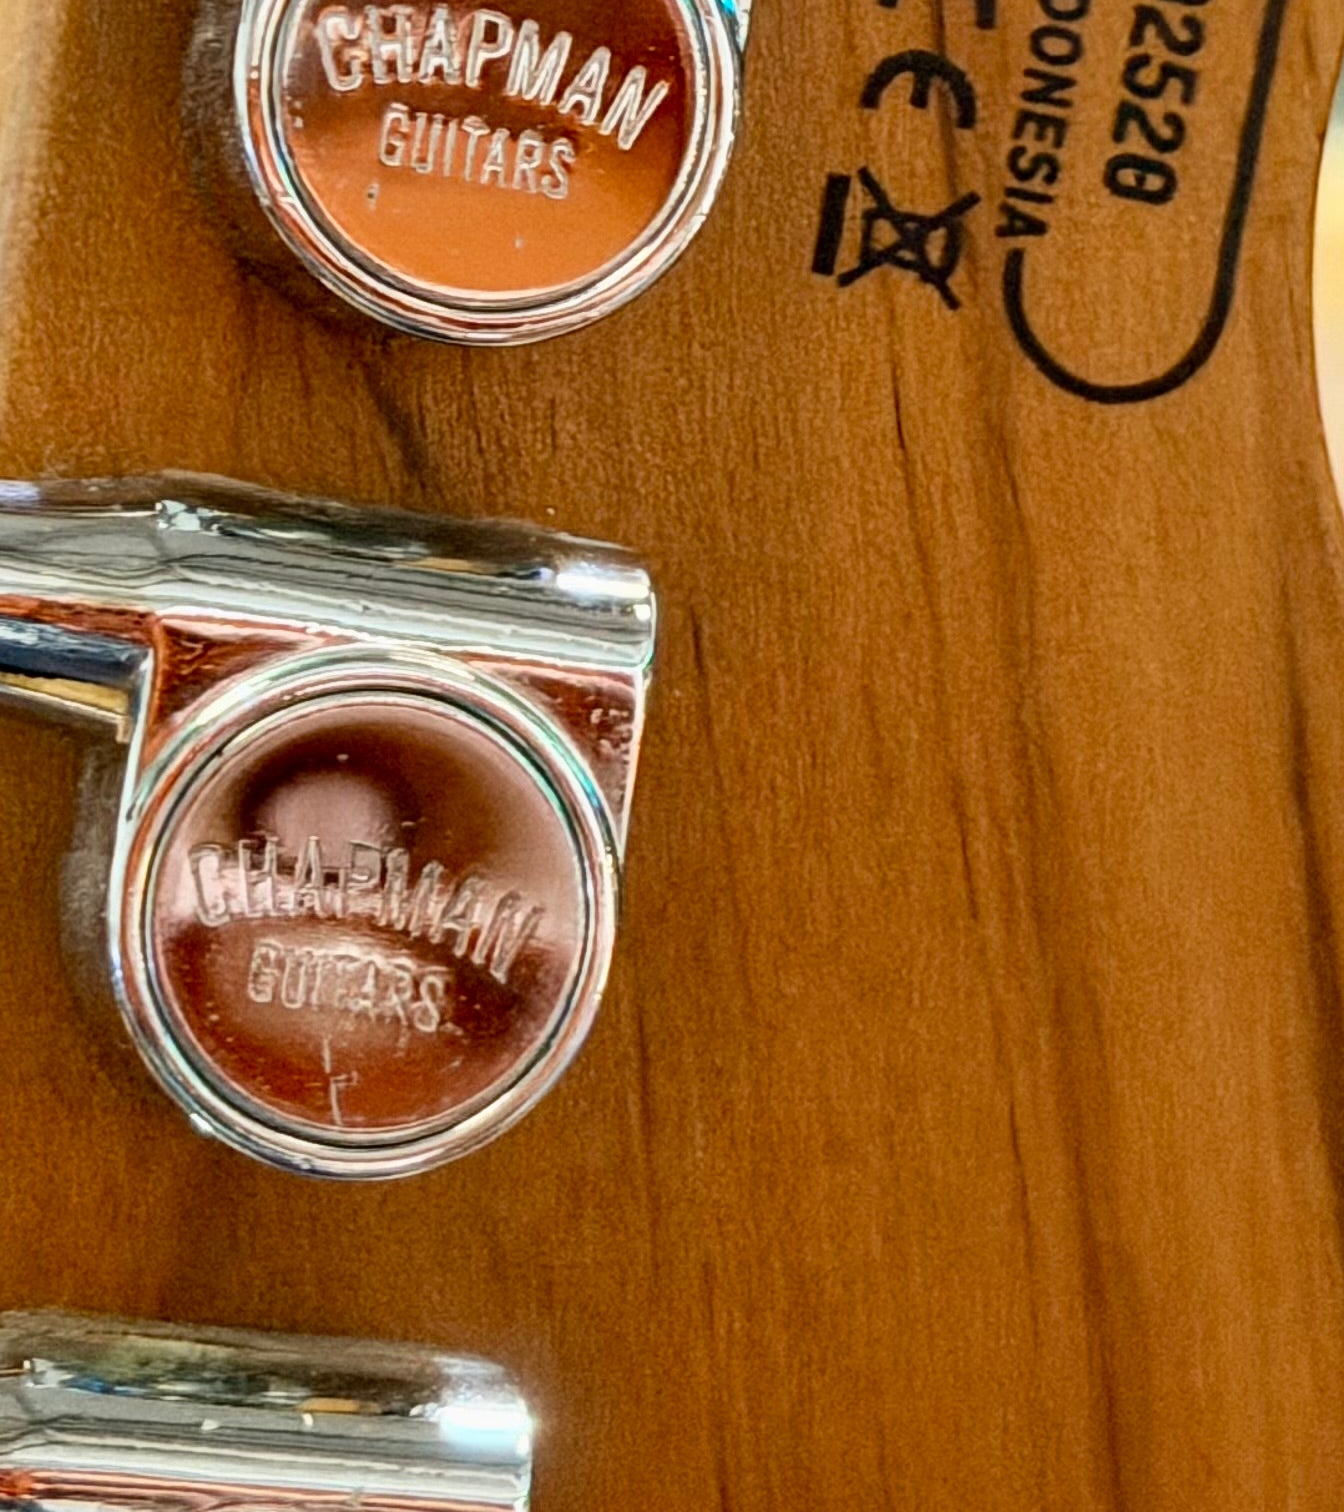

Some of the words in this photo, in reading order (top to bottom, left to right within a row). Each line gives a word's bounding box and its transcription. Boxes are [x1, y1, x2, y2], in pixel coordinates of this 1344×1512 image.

[316, 3, 671, 151] CHAPMAN
[379, 102, 577, 201] GUITARS
[188, 835, 546, 985] CHAPMAN
[248, 938, 449, 1033] GUITARS
